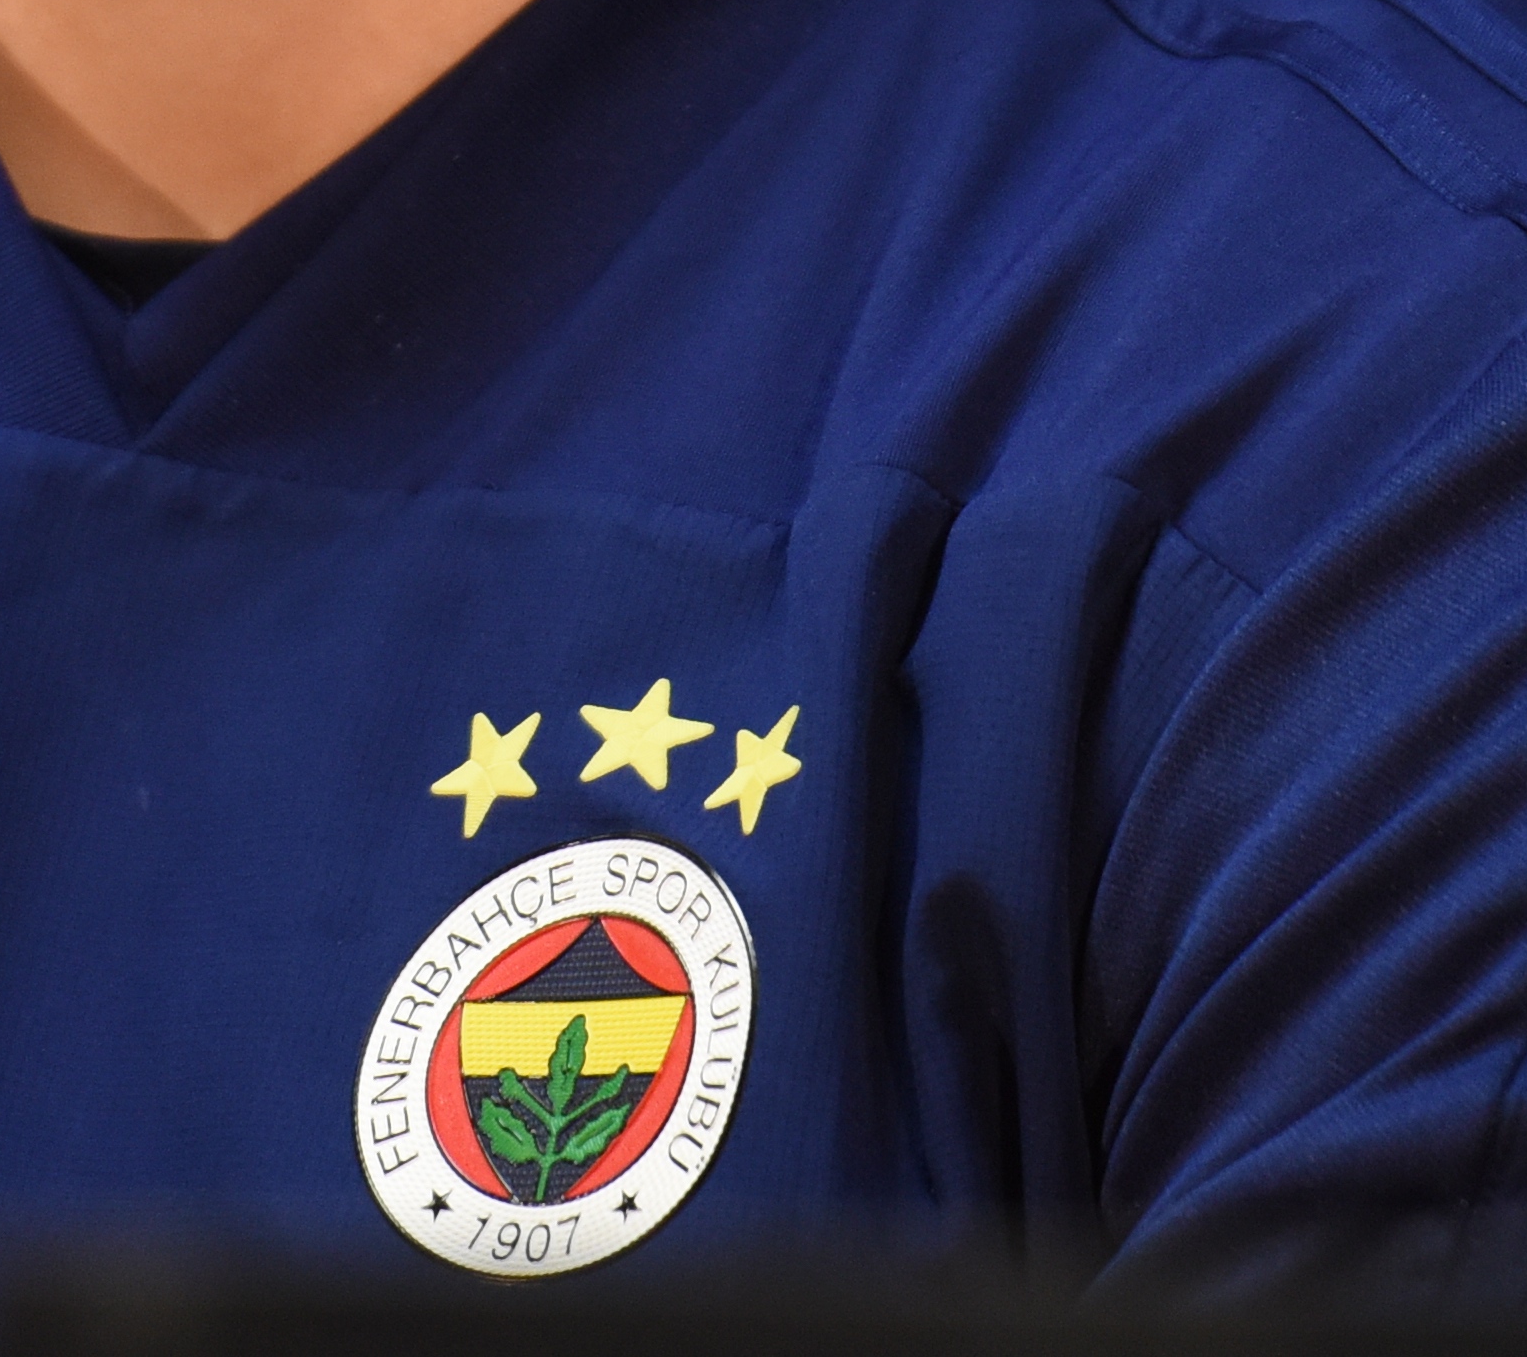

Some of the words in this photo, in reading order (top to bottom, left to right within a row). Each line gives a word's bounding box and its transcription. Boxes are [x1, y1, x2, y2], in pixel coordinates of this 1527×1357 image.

[370, 856, 579, 1176] FENERBAHÇE
[601, 852, 714, 942] SPOR
[667, 940, 741, 1175] KULÜBÜ
[466, 1215, 582, 1264] 1907
